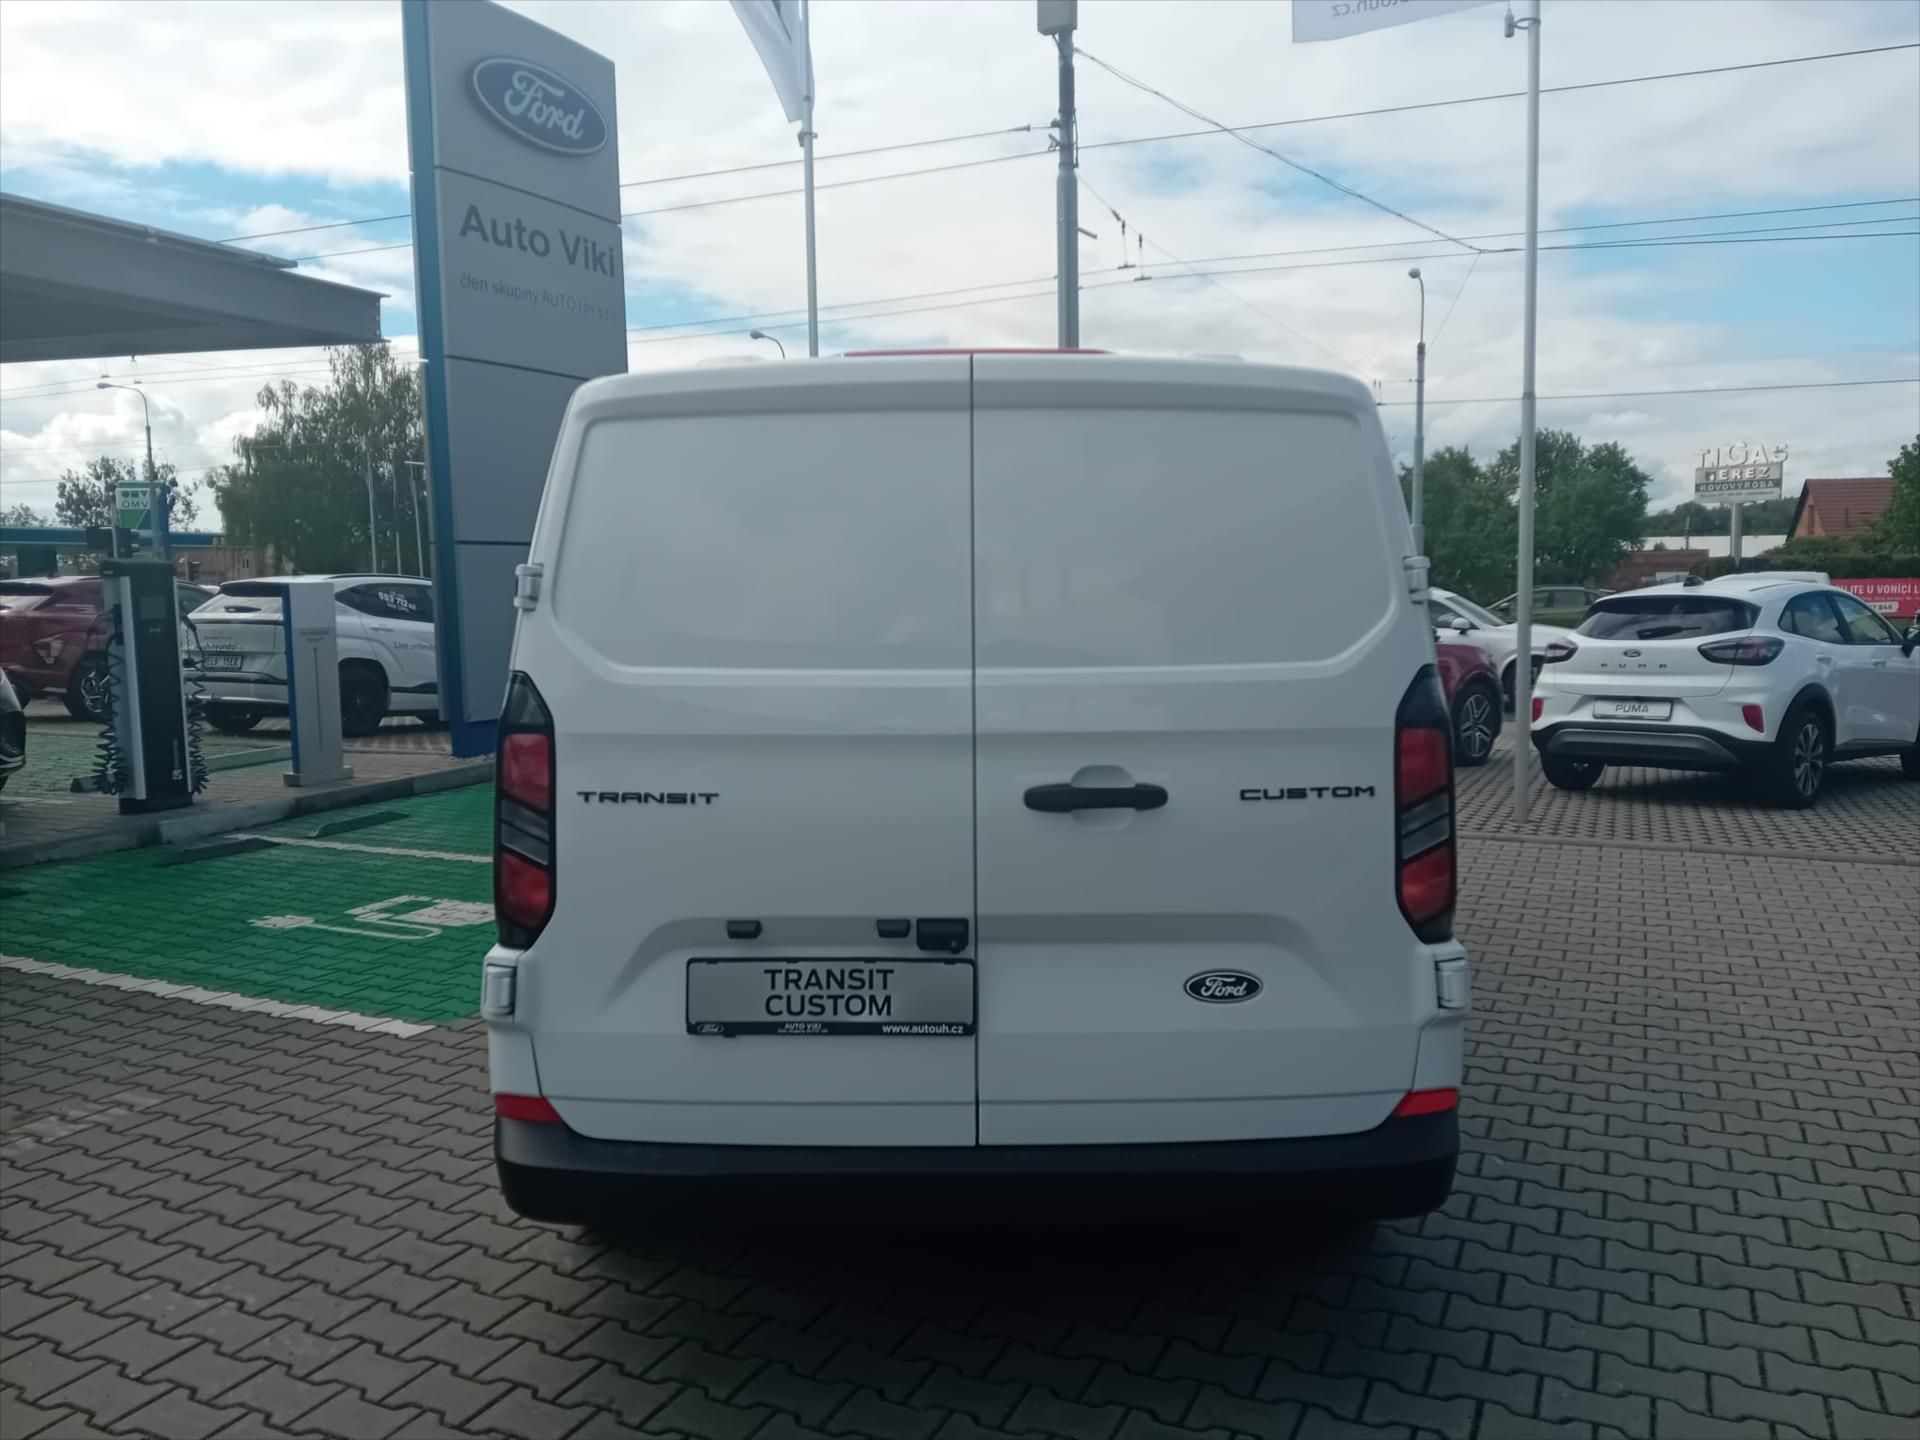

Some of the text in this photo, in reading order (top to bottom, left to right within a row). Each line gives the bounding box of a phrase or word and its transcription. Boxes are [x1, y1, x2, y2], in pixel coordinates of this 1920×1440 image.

[503, 70, 585, 140] Ford
[459, 204, 615, 277] Auto Viki
[492, 280, 538, 306] skupiny
[121, 500, 149, 508] OMV
[1615, 704, 1649, 713] PUMA
[576, 791, 720, 805] TRANSIT
[1240, 786, 1376, 801] CUSTOM
[763, 968, 895, 991] TRANSIT
[1200, 976, 1248, 997] Ford
[764, 994, 893, 1017] CUSTOM
[882, 1023, 964, 1034] www.autouh.cz
